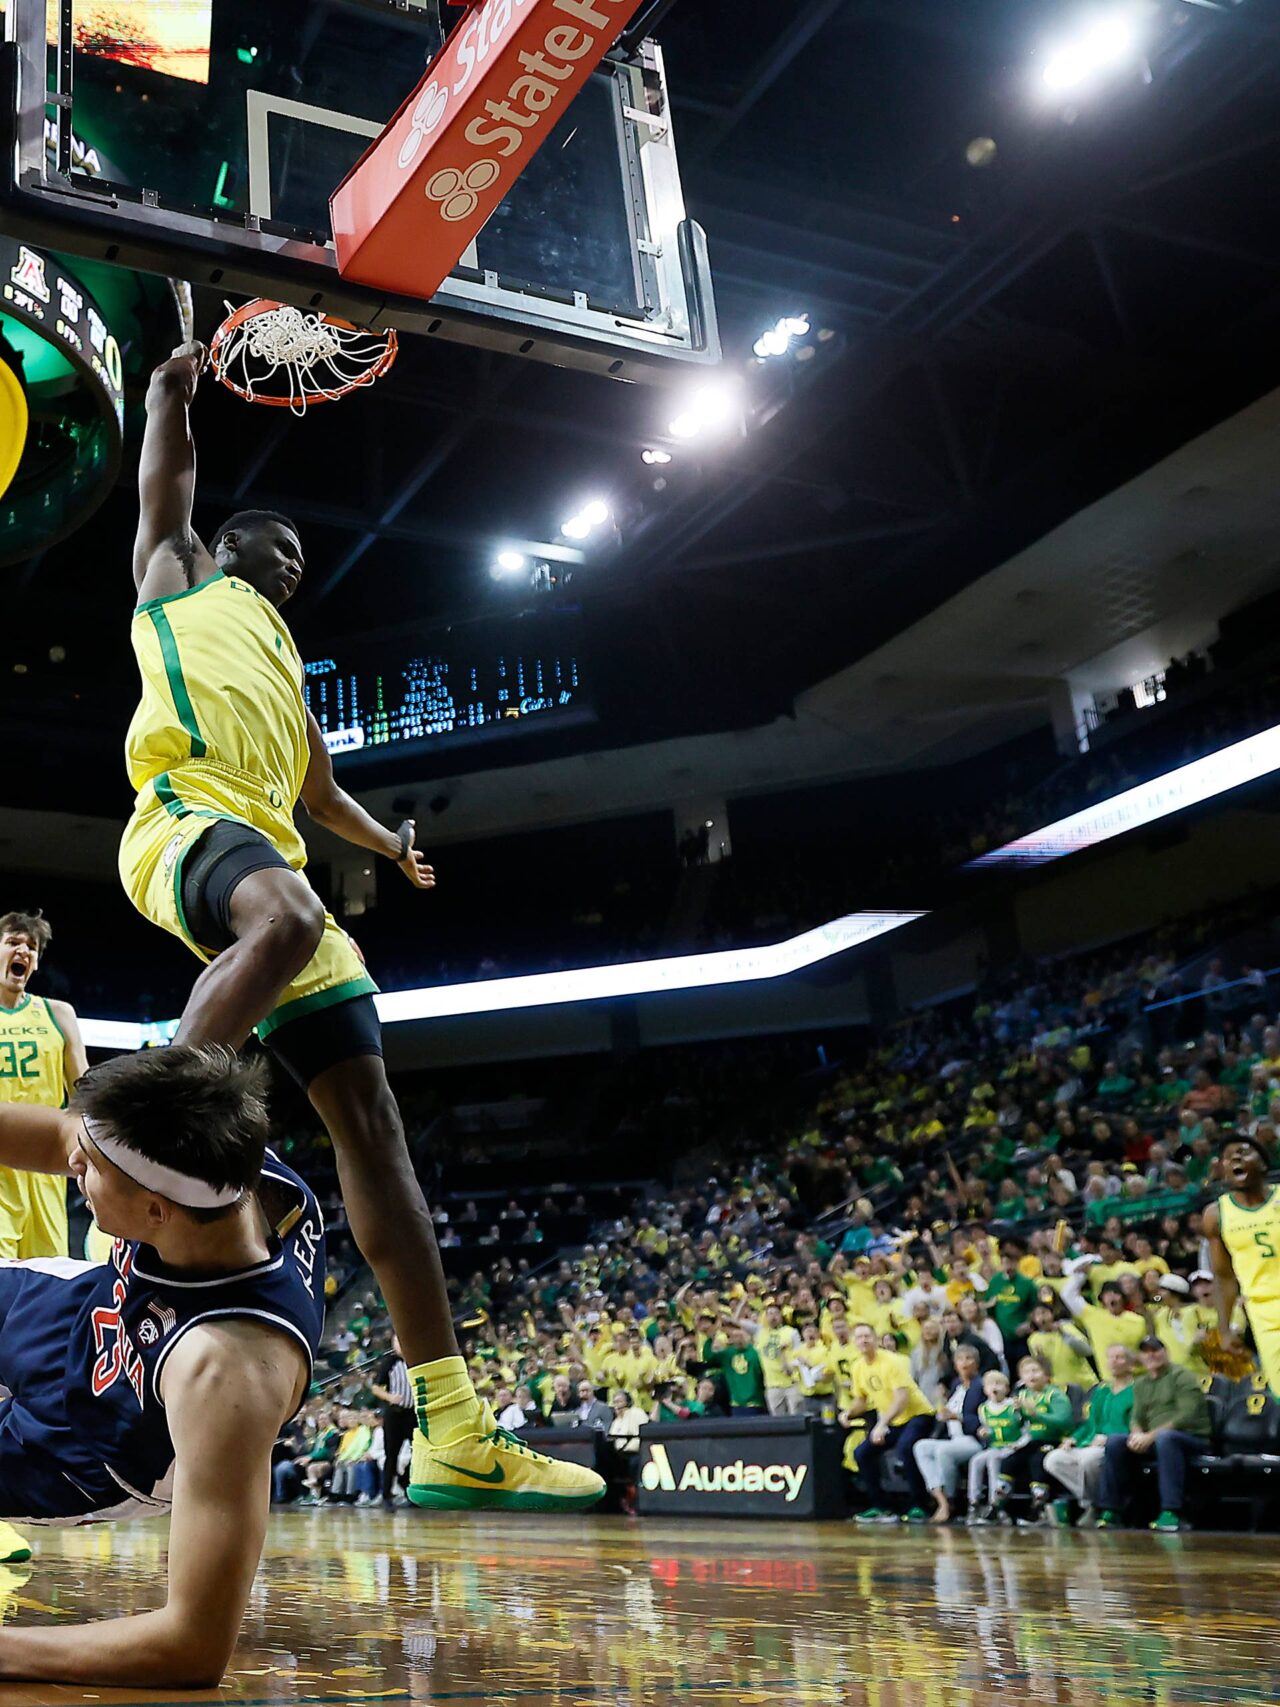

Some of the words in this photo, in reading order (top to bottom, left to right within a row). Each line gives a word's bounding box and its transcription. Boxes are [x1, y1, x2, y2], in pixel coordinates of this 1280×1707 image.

[452, 0, 522, 96] Sta
[11, 246, 50, 304] A
[328, 734, 358, 749] ank
[1254, 1232, 1275, 1258] 5
[677, 1460, 808, 1502] Audacy
